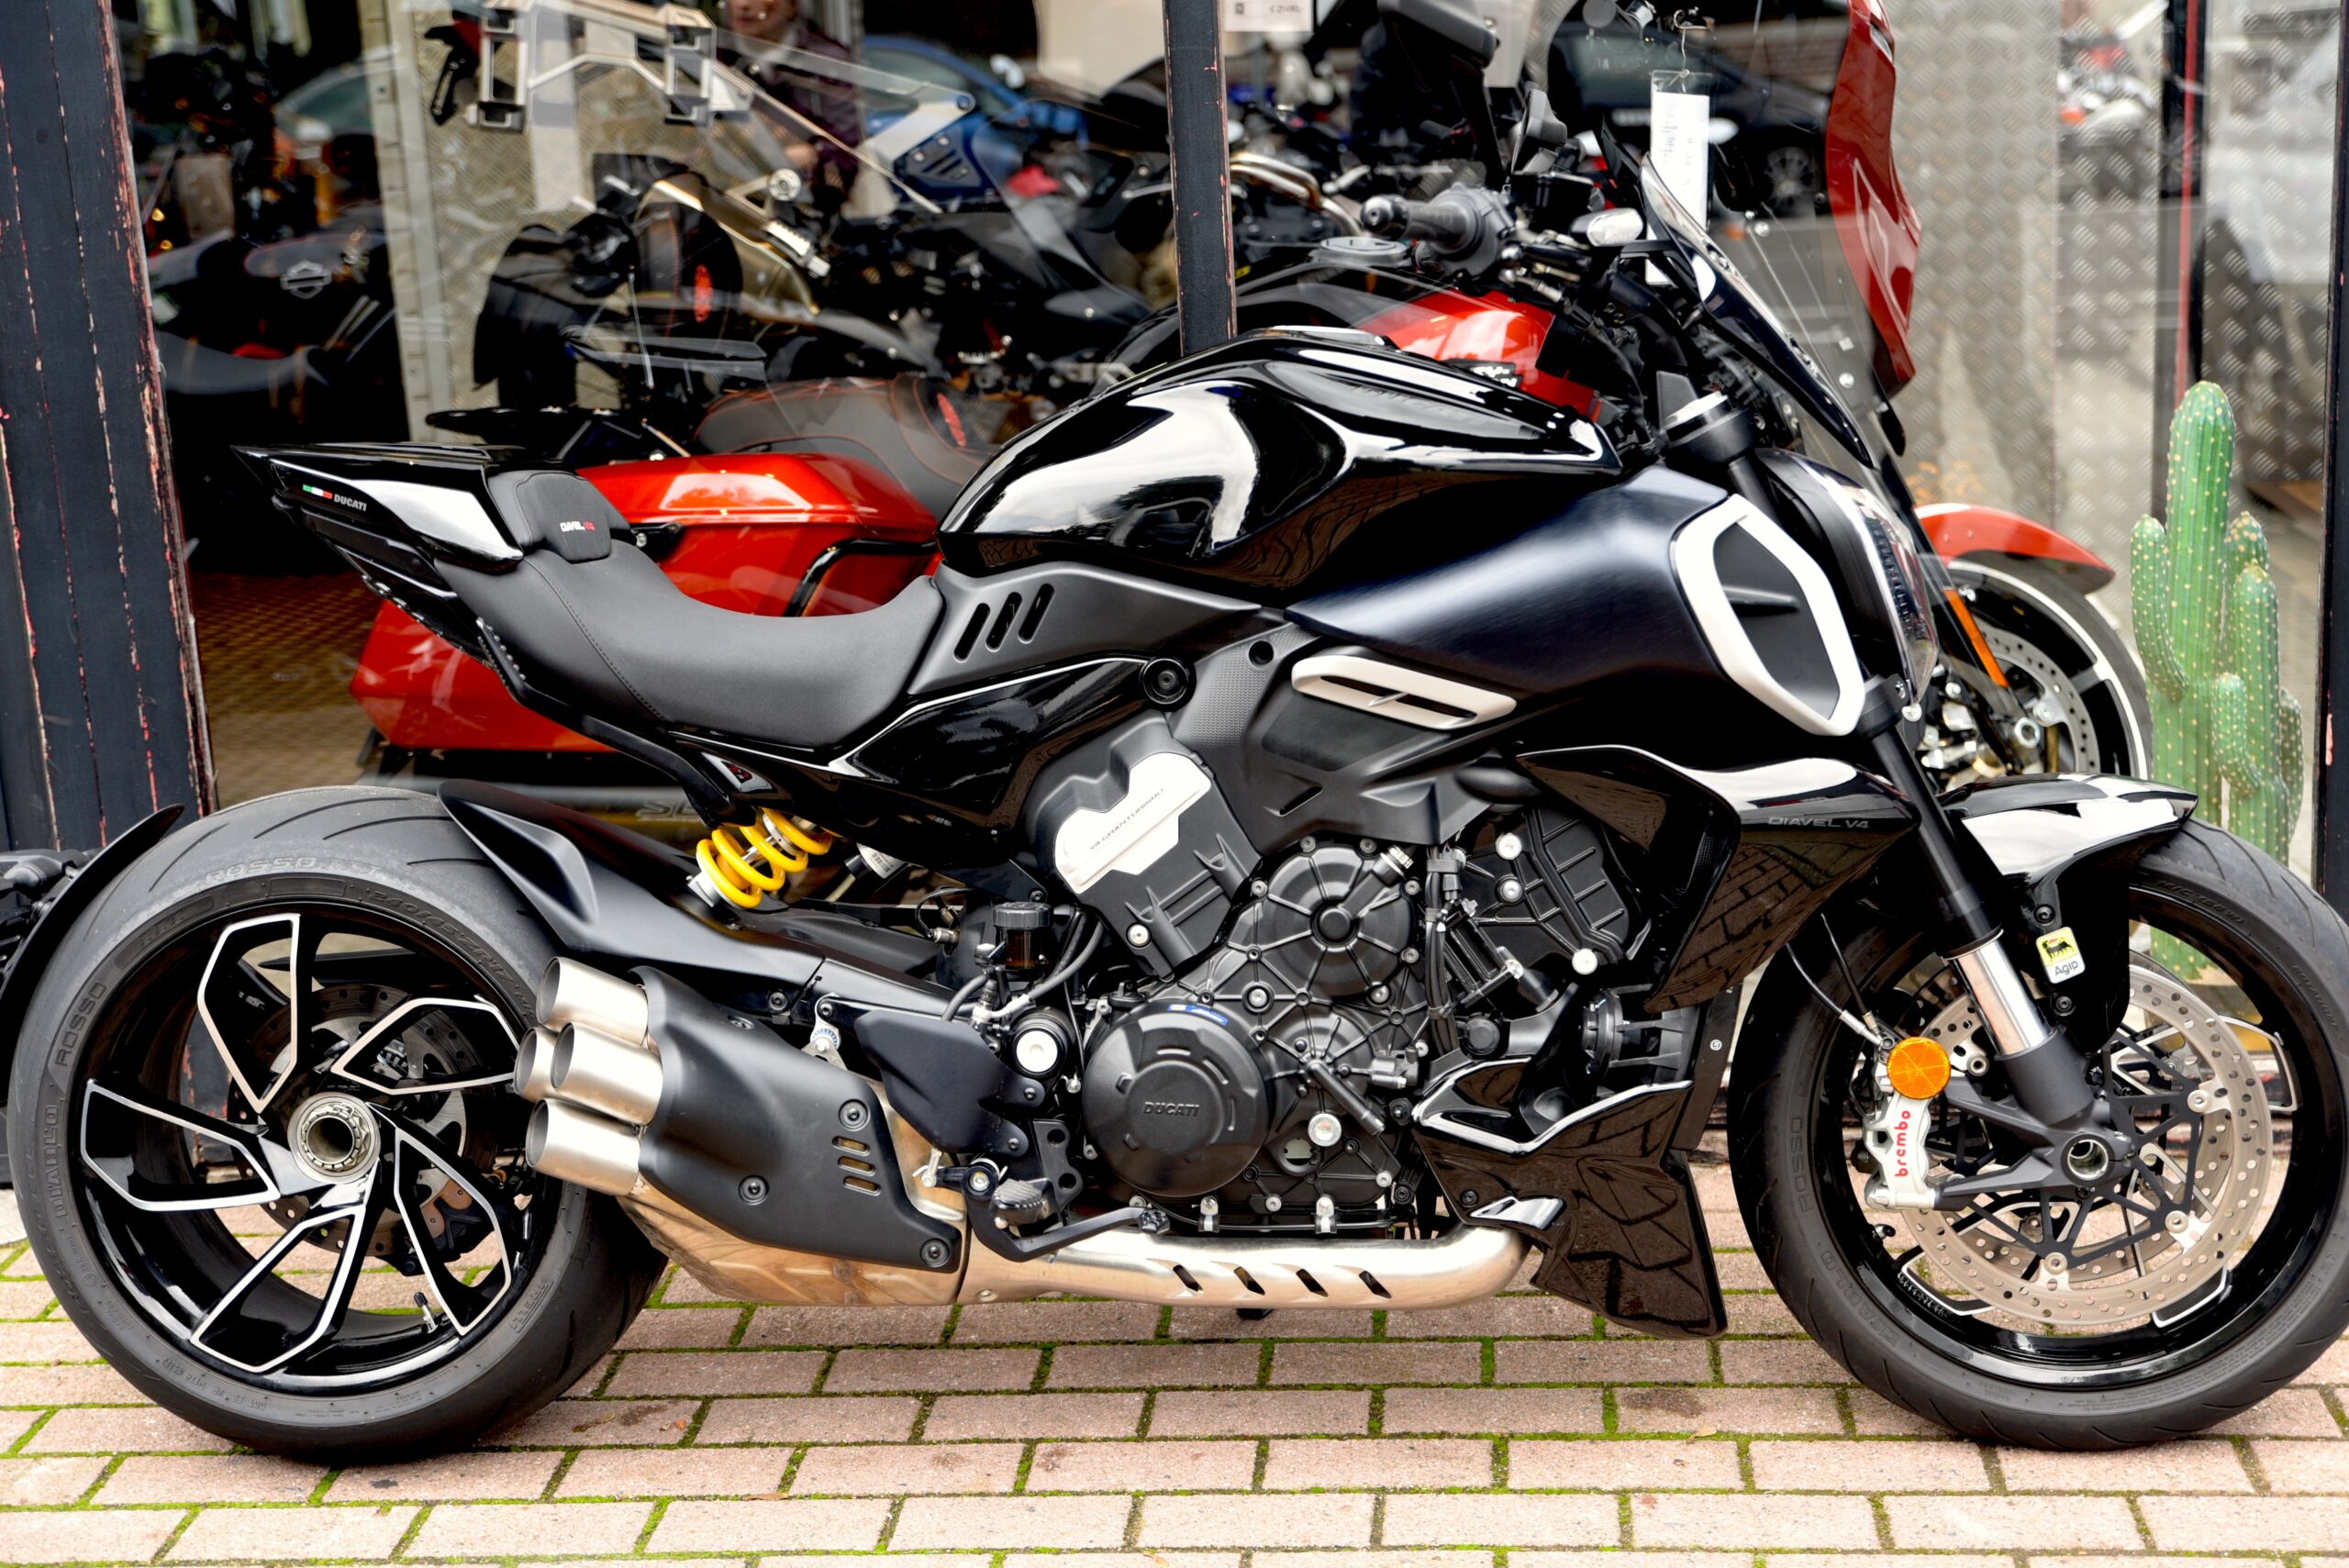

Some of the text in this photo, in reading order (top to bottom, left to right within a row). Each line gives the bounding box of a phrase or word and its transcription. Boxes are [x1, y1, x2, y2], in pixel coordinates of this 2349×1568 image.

[334, 492, 367, 512] DUCATI
[1101, 787, 1165, 842] GRANTURISMO
[1767, 817, 1870, 829] DIAVEL V4
[203, 856, 317, 884] ROSSO
[2054, 960, 2079, 976] Agip
[53, 980, 107, 1067] ROSSO
[1143, 1101, 1200, 1117] DUCATI
[43, 1103, 69, 1218] DIABLO
[1894, 1110, 1911, 1177] brembo
[1788, 1117, 1816, 1212] ROSSO
